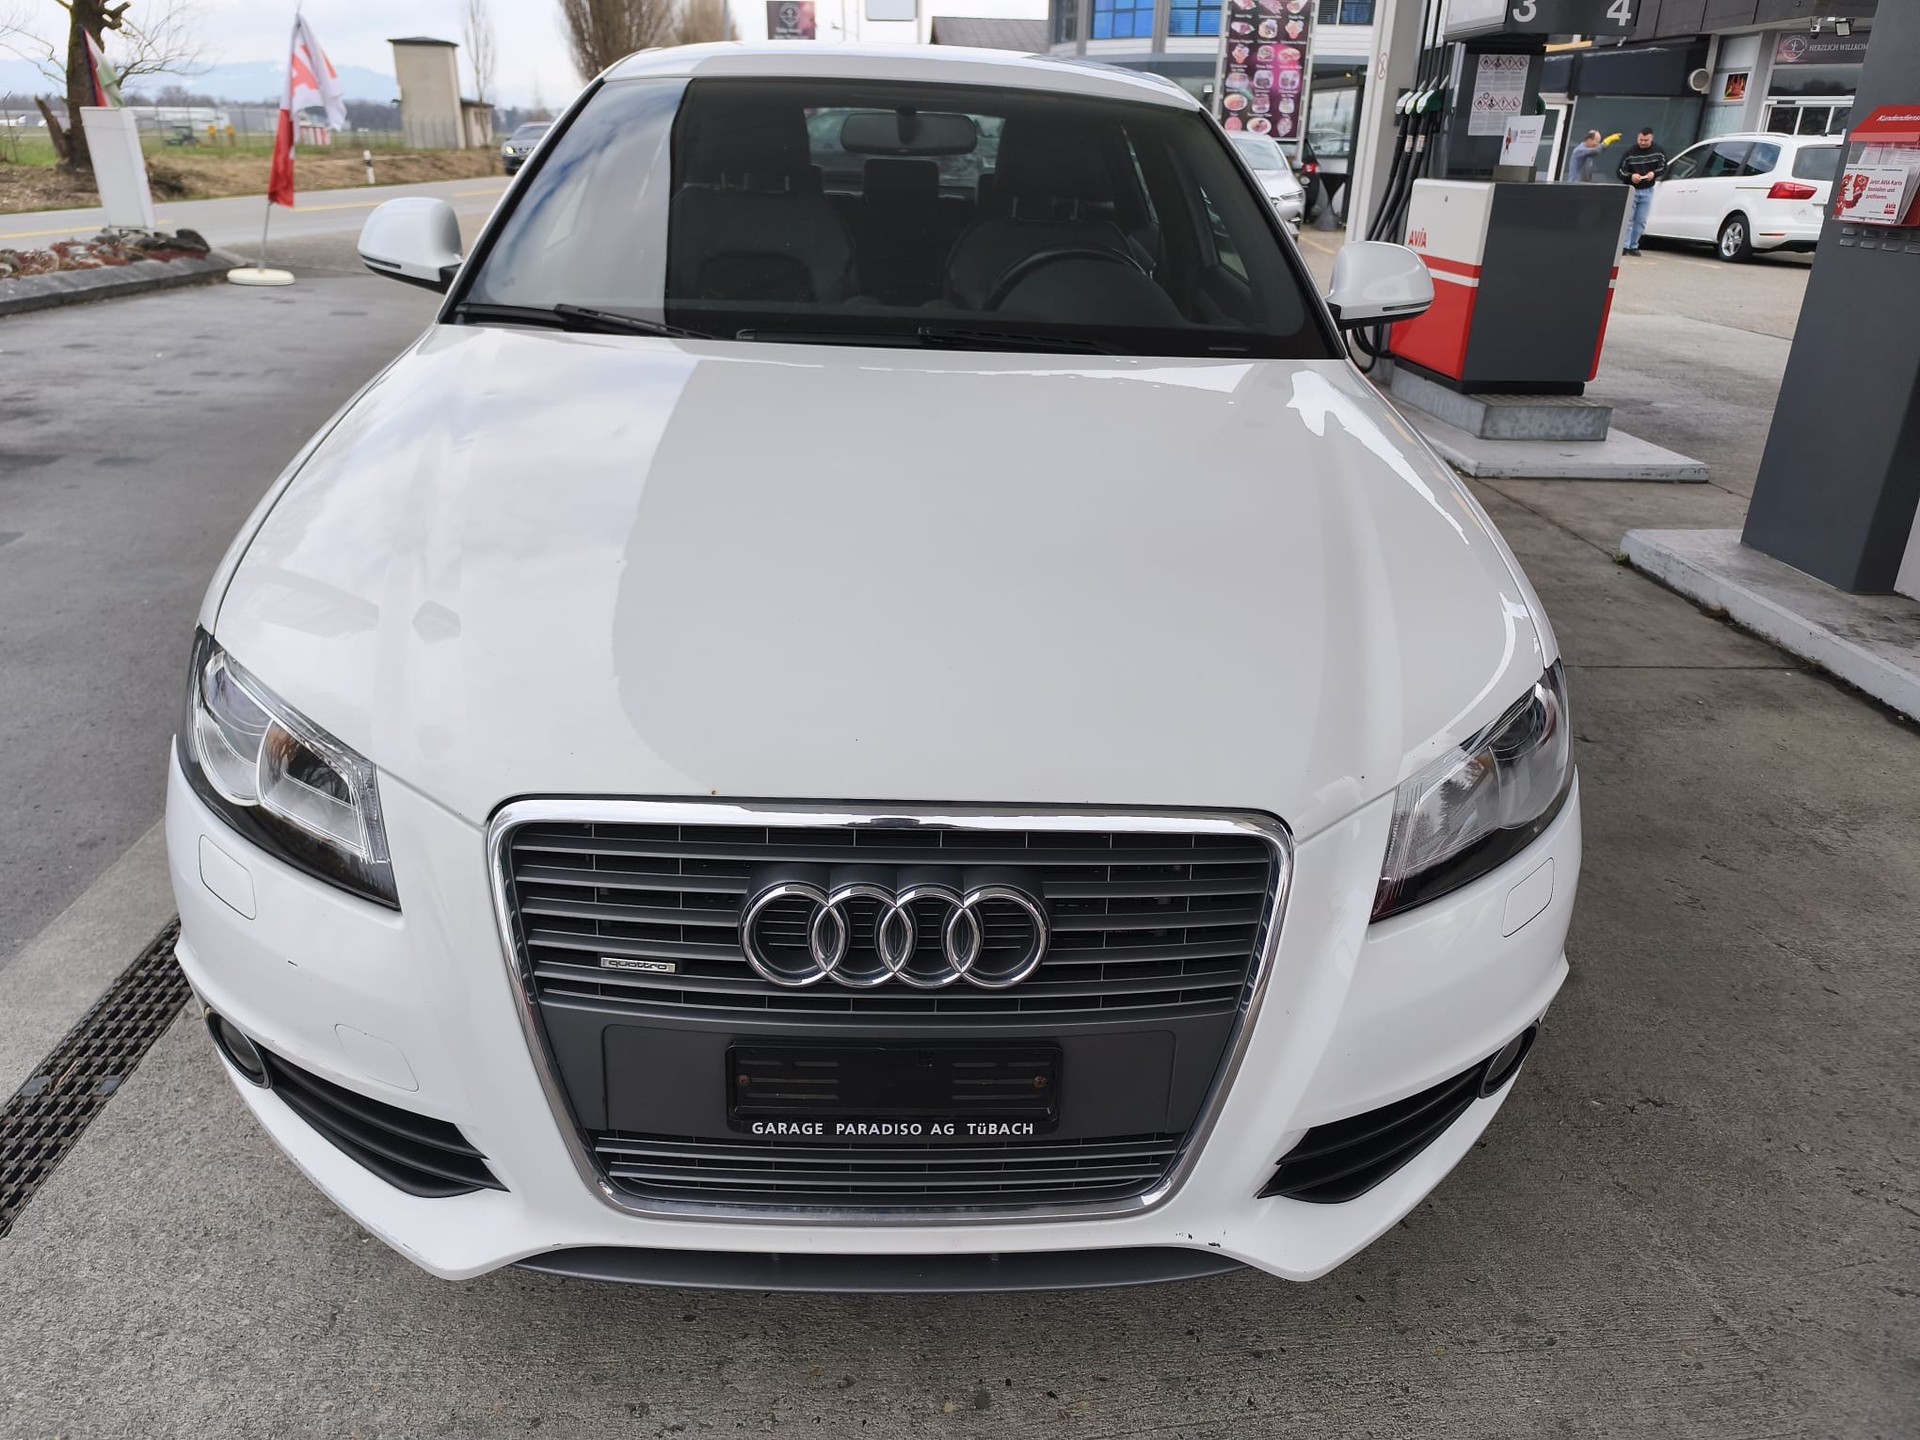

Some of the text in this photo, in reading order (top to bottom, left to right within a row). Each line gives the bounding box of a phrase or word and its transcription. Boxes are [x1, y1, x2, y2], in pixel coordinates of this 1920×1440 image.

[1512, 0, 1632, 27] 3 4
[1809, 44, 1838, 52] HERZLICH
[1408, 230, 1427, 248] AVIA
[608, 960, 667, 970] quattro
[752, 1122, 824, 1136] GARAGE
[836, 1122, 922, 1136] PARADISO
[930, 1122, 955, 1136] AG
